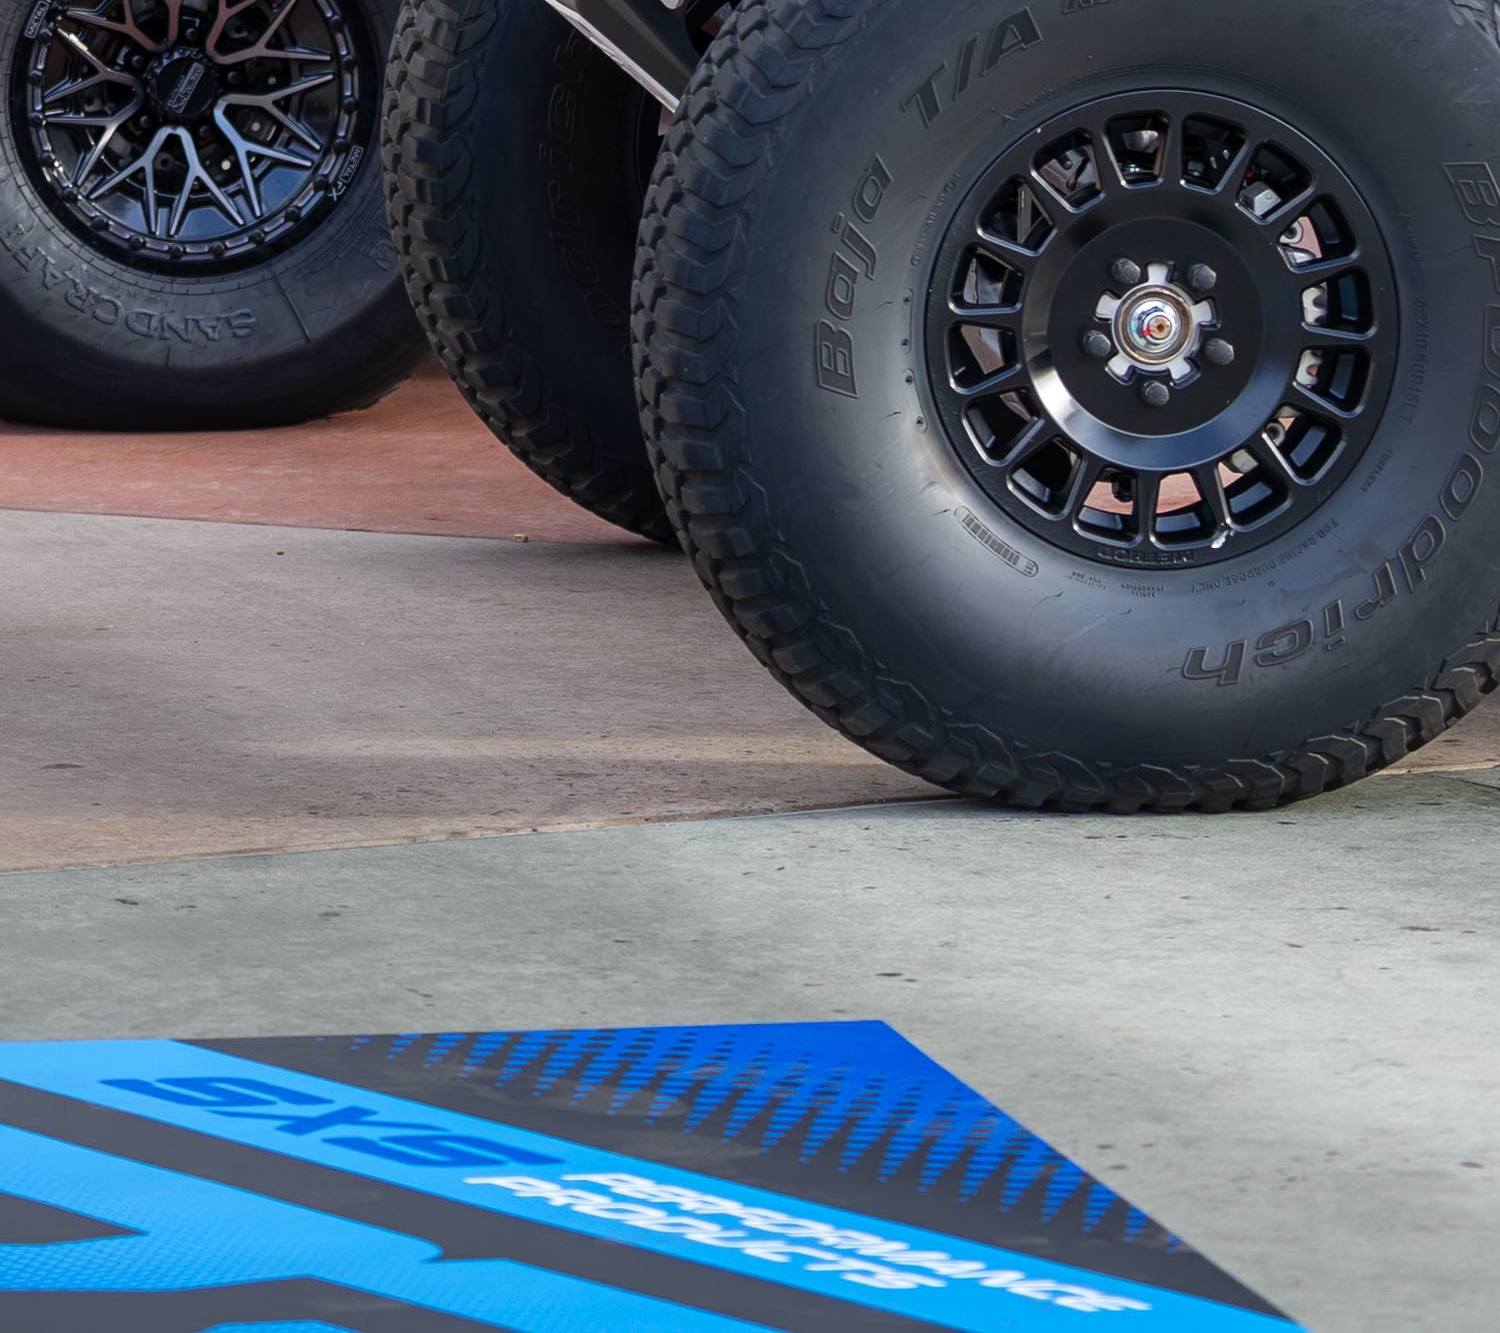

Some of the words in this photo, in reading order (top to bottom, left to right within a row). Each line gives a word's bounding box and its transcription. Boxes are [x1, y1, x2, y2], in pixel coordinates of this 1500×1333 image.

[26, 3, 49, 37] METAL
[815, 154, 895, 400] Baja
[898, 6, 1042, 129] T/A
[98, 1077, 562, 1166] SXS
[463, 1176, 946, 1290] PRODUCTS
[562, 1174, 1152, 1313] PERFORMANCE
